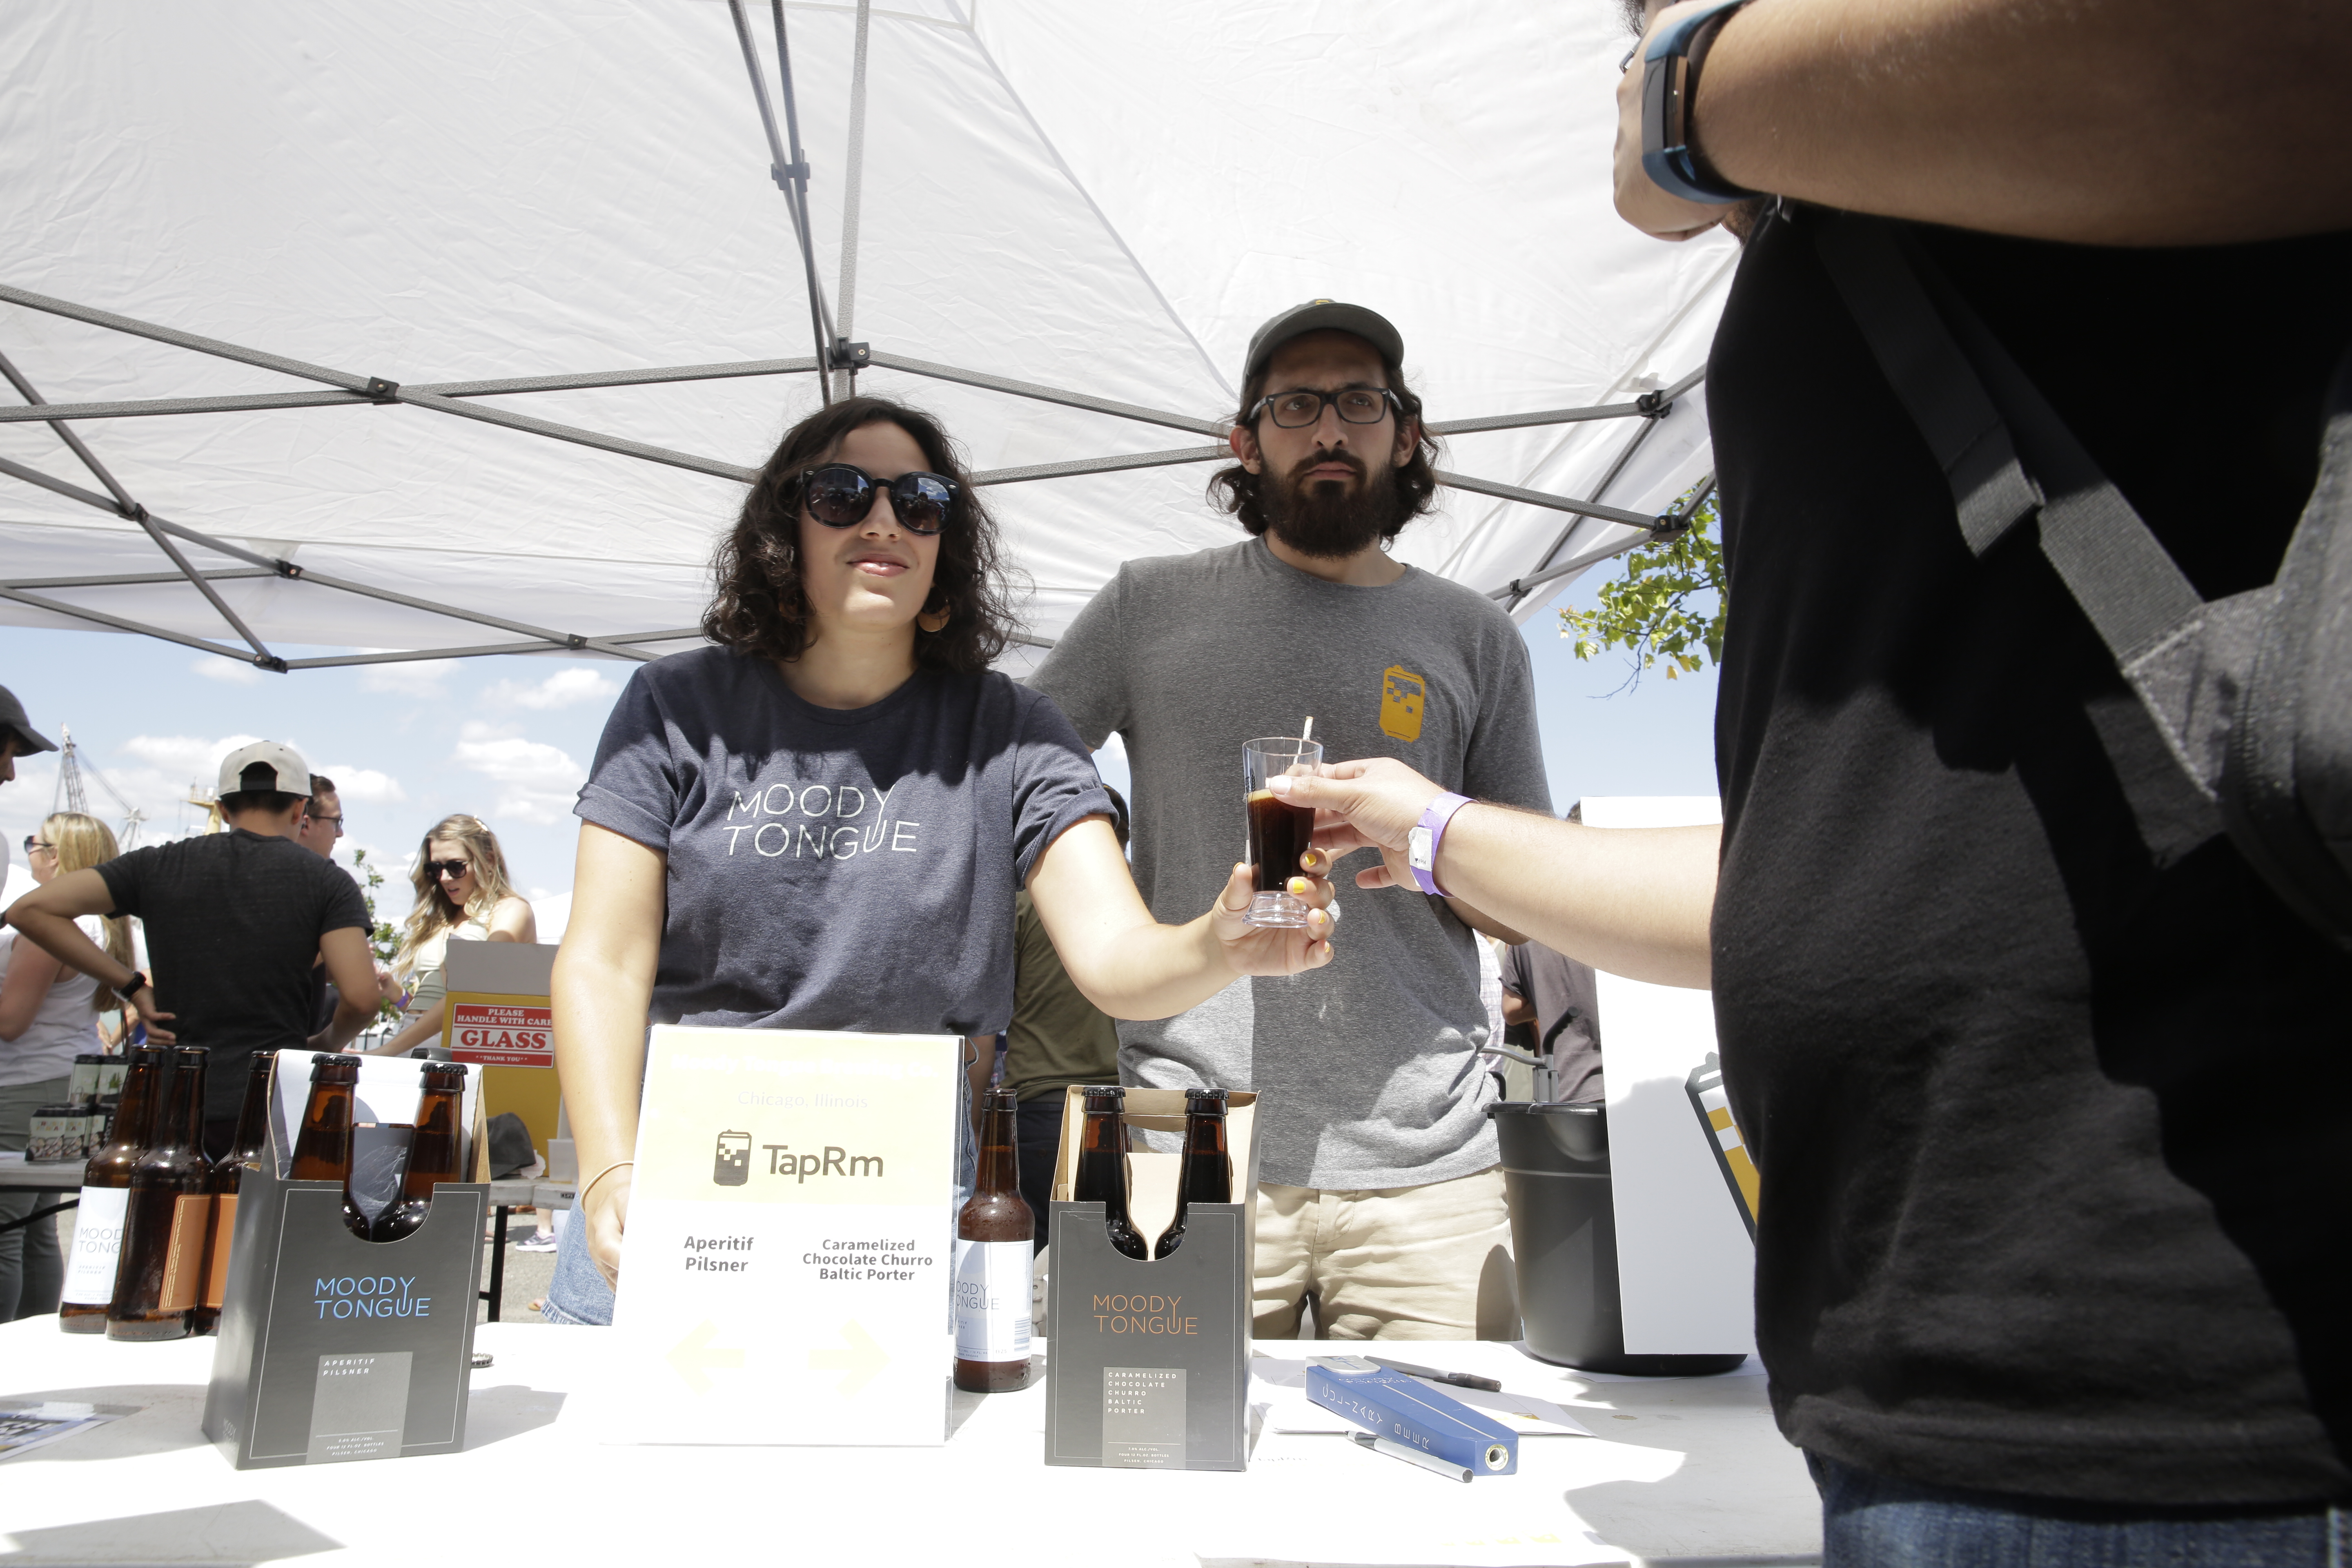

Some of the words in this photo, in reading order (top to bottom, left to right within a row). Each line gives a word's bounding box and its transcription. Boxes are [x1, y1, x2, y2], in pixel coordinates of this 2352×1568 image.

[727, 784, 896, 843] MOODY
[723, 819, 920, 860] TONGUE
[457, 1015, 497, 1024] HANDLE
[499, 1017, 525, 1025] WITH
[488, 1008, 524, 1017] PLEASE
[461, 1030, 546, 1049] GLASS
[737, 1090, 808, 1109] Chicago,
[814, 1094, 868, 1109] Illinois
[762, 1144, 883, 1184] TapRm
[79, 1227, 122, 1240] MOOD
[78, 1240, 121, 1254] TONG
[684, 1236, 755, 1252] Aperitif
[822, 1239, 915, 1251] Caramelized
[685, 1256, 748, 1272] Pilsner
[802, 1253, 877, 1265] Chocolate
[881, 1254, 933, 1266] Churro
[820, 1268, 862, 1280] Baltic
[867, 1269, 915, 1281] Porter
[314, 1276, 416, 1311] MOODY
[957, 1281, 989, 1306] OODY
[314, 1297, 431, 1319] TONGUE
[956, 1294, 999, 1310] ONGUE
[1094, 1294, 1181, 1329] MOODY
[1094, 1315, 1198, 1334] TONGUE
[324, 1358, 375, 1366] APERITIF
[323, 1368, 369, 1376] PILSNER
[1323, 1384, 1383, 1424] CULINARY
[1394, 1423, 1429, 1450] BEER
